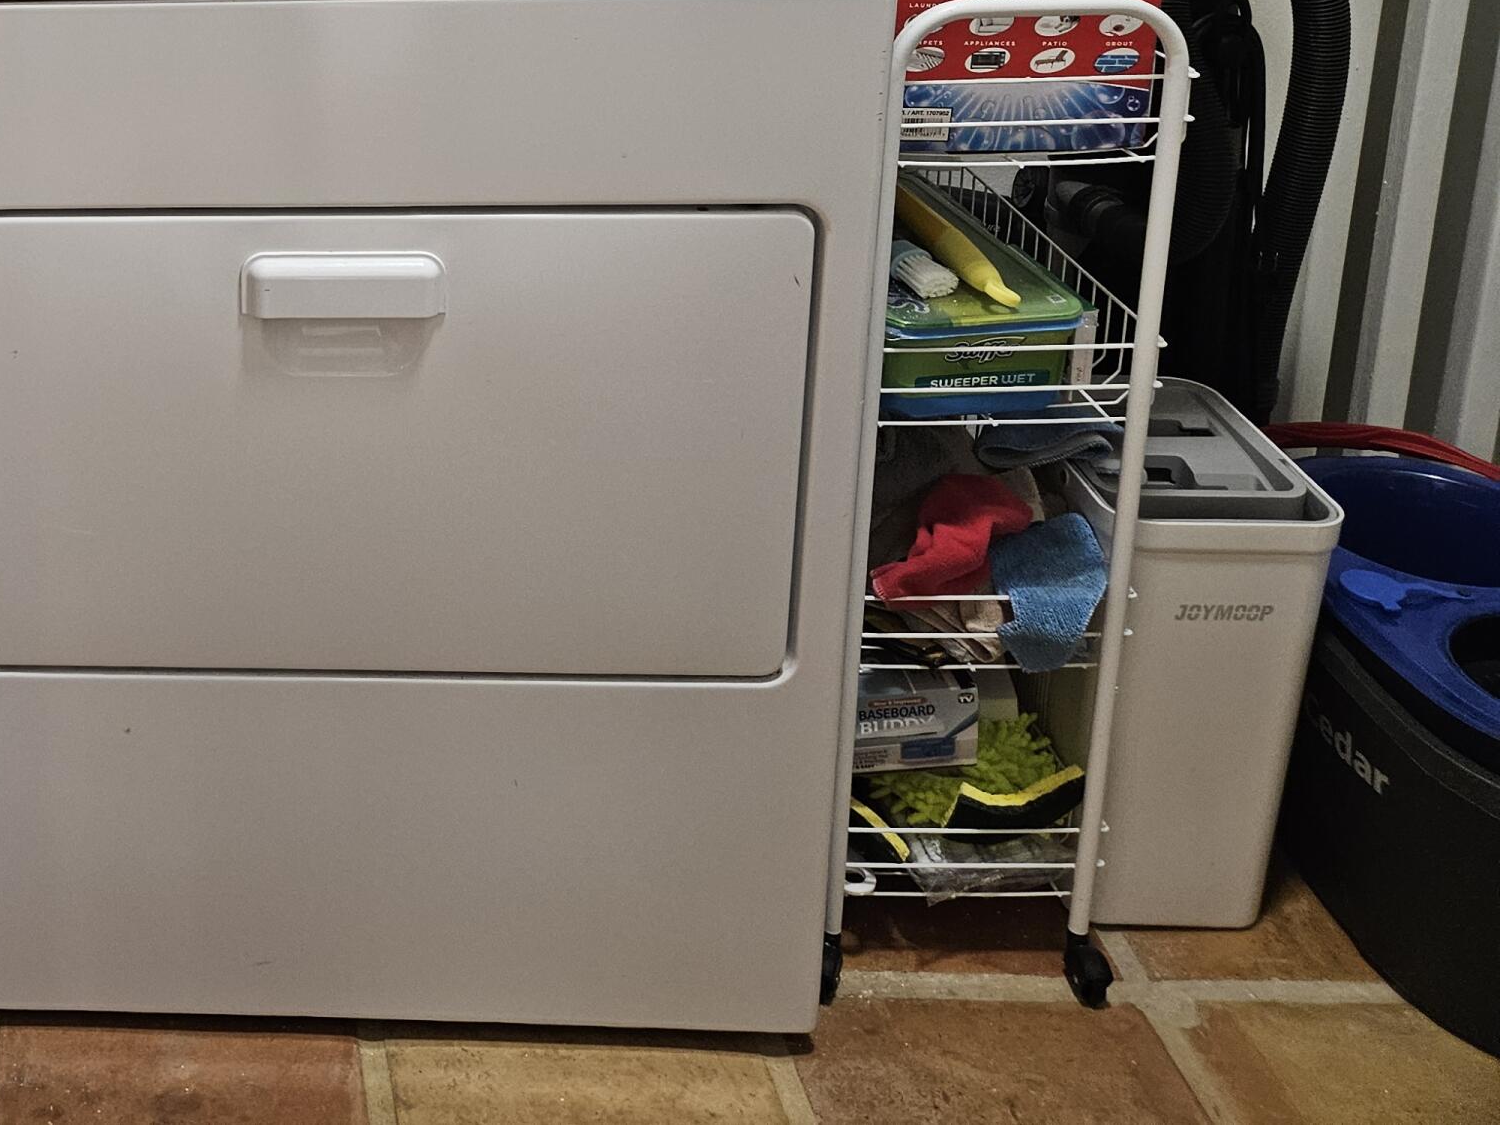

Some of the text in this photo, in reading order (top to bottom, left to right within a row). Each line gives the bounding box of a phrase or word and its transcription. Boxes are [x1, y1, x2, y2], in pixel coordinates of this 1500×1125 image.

[944, 336, 1026, 363] Swiffer
[930, 373, 1036, 388] SWEEPER WET
[1174, 604, 1274, 621] JOYMOOP
[959, 694, 974, 703] TV
[858, 704, 935, 721] BASEBOARD
